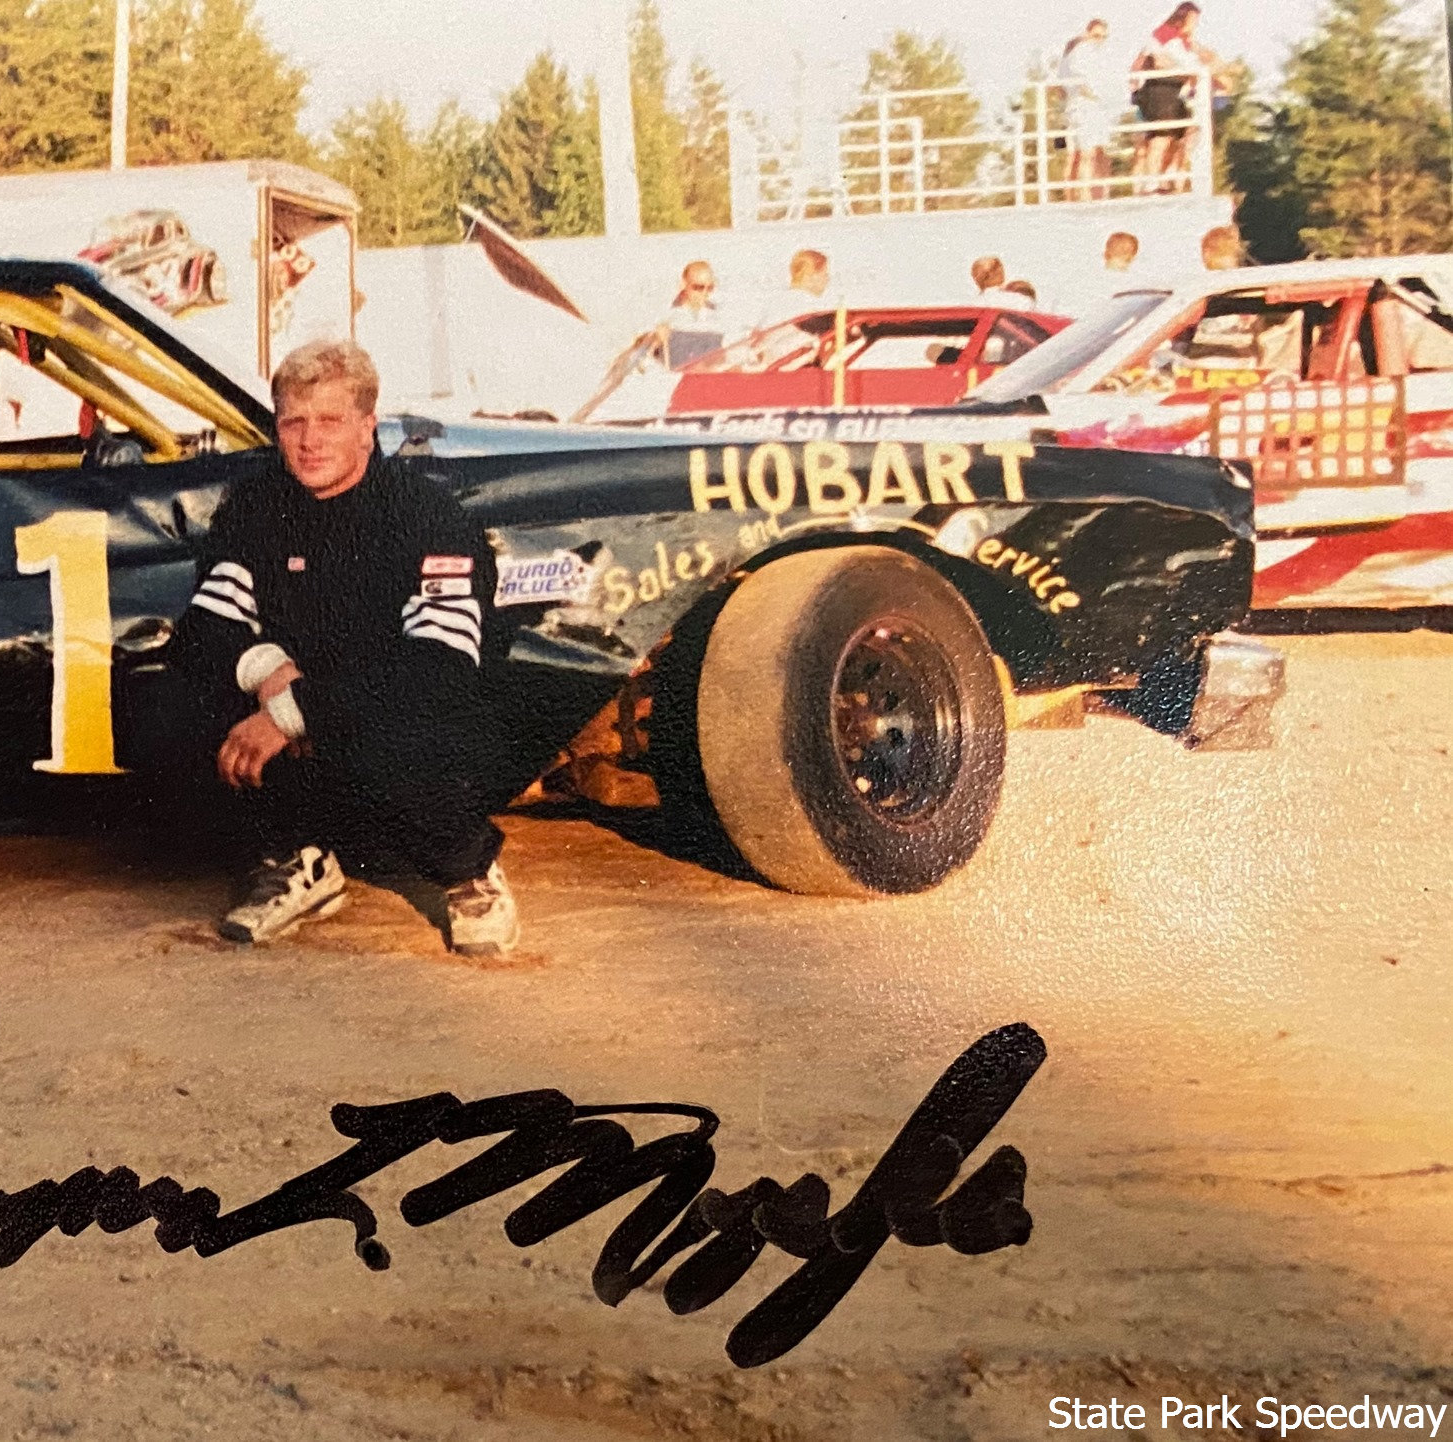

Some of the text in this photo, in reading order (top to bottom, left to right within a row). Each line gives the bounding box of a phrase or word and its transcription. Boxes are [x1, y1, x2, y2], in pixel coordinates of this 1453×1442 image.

[689, 439, 1036, 514] HOBART
[502, 557, 574, 583] TURBO
[603, 540, 715, 615] Sales
[738, 513, 783, 549] and
